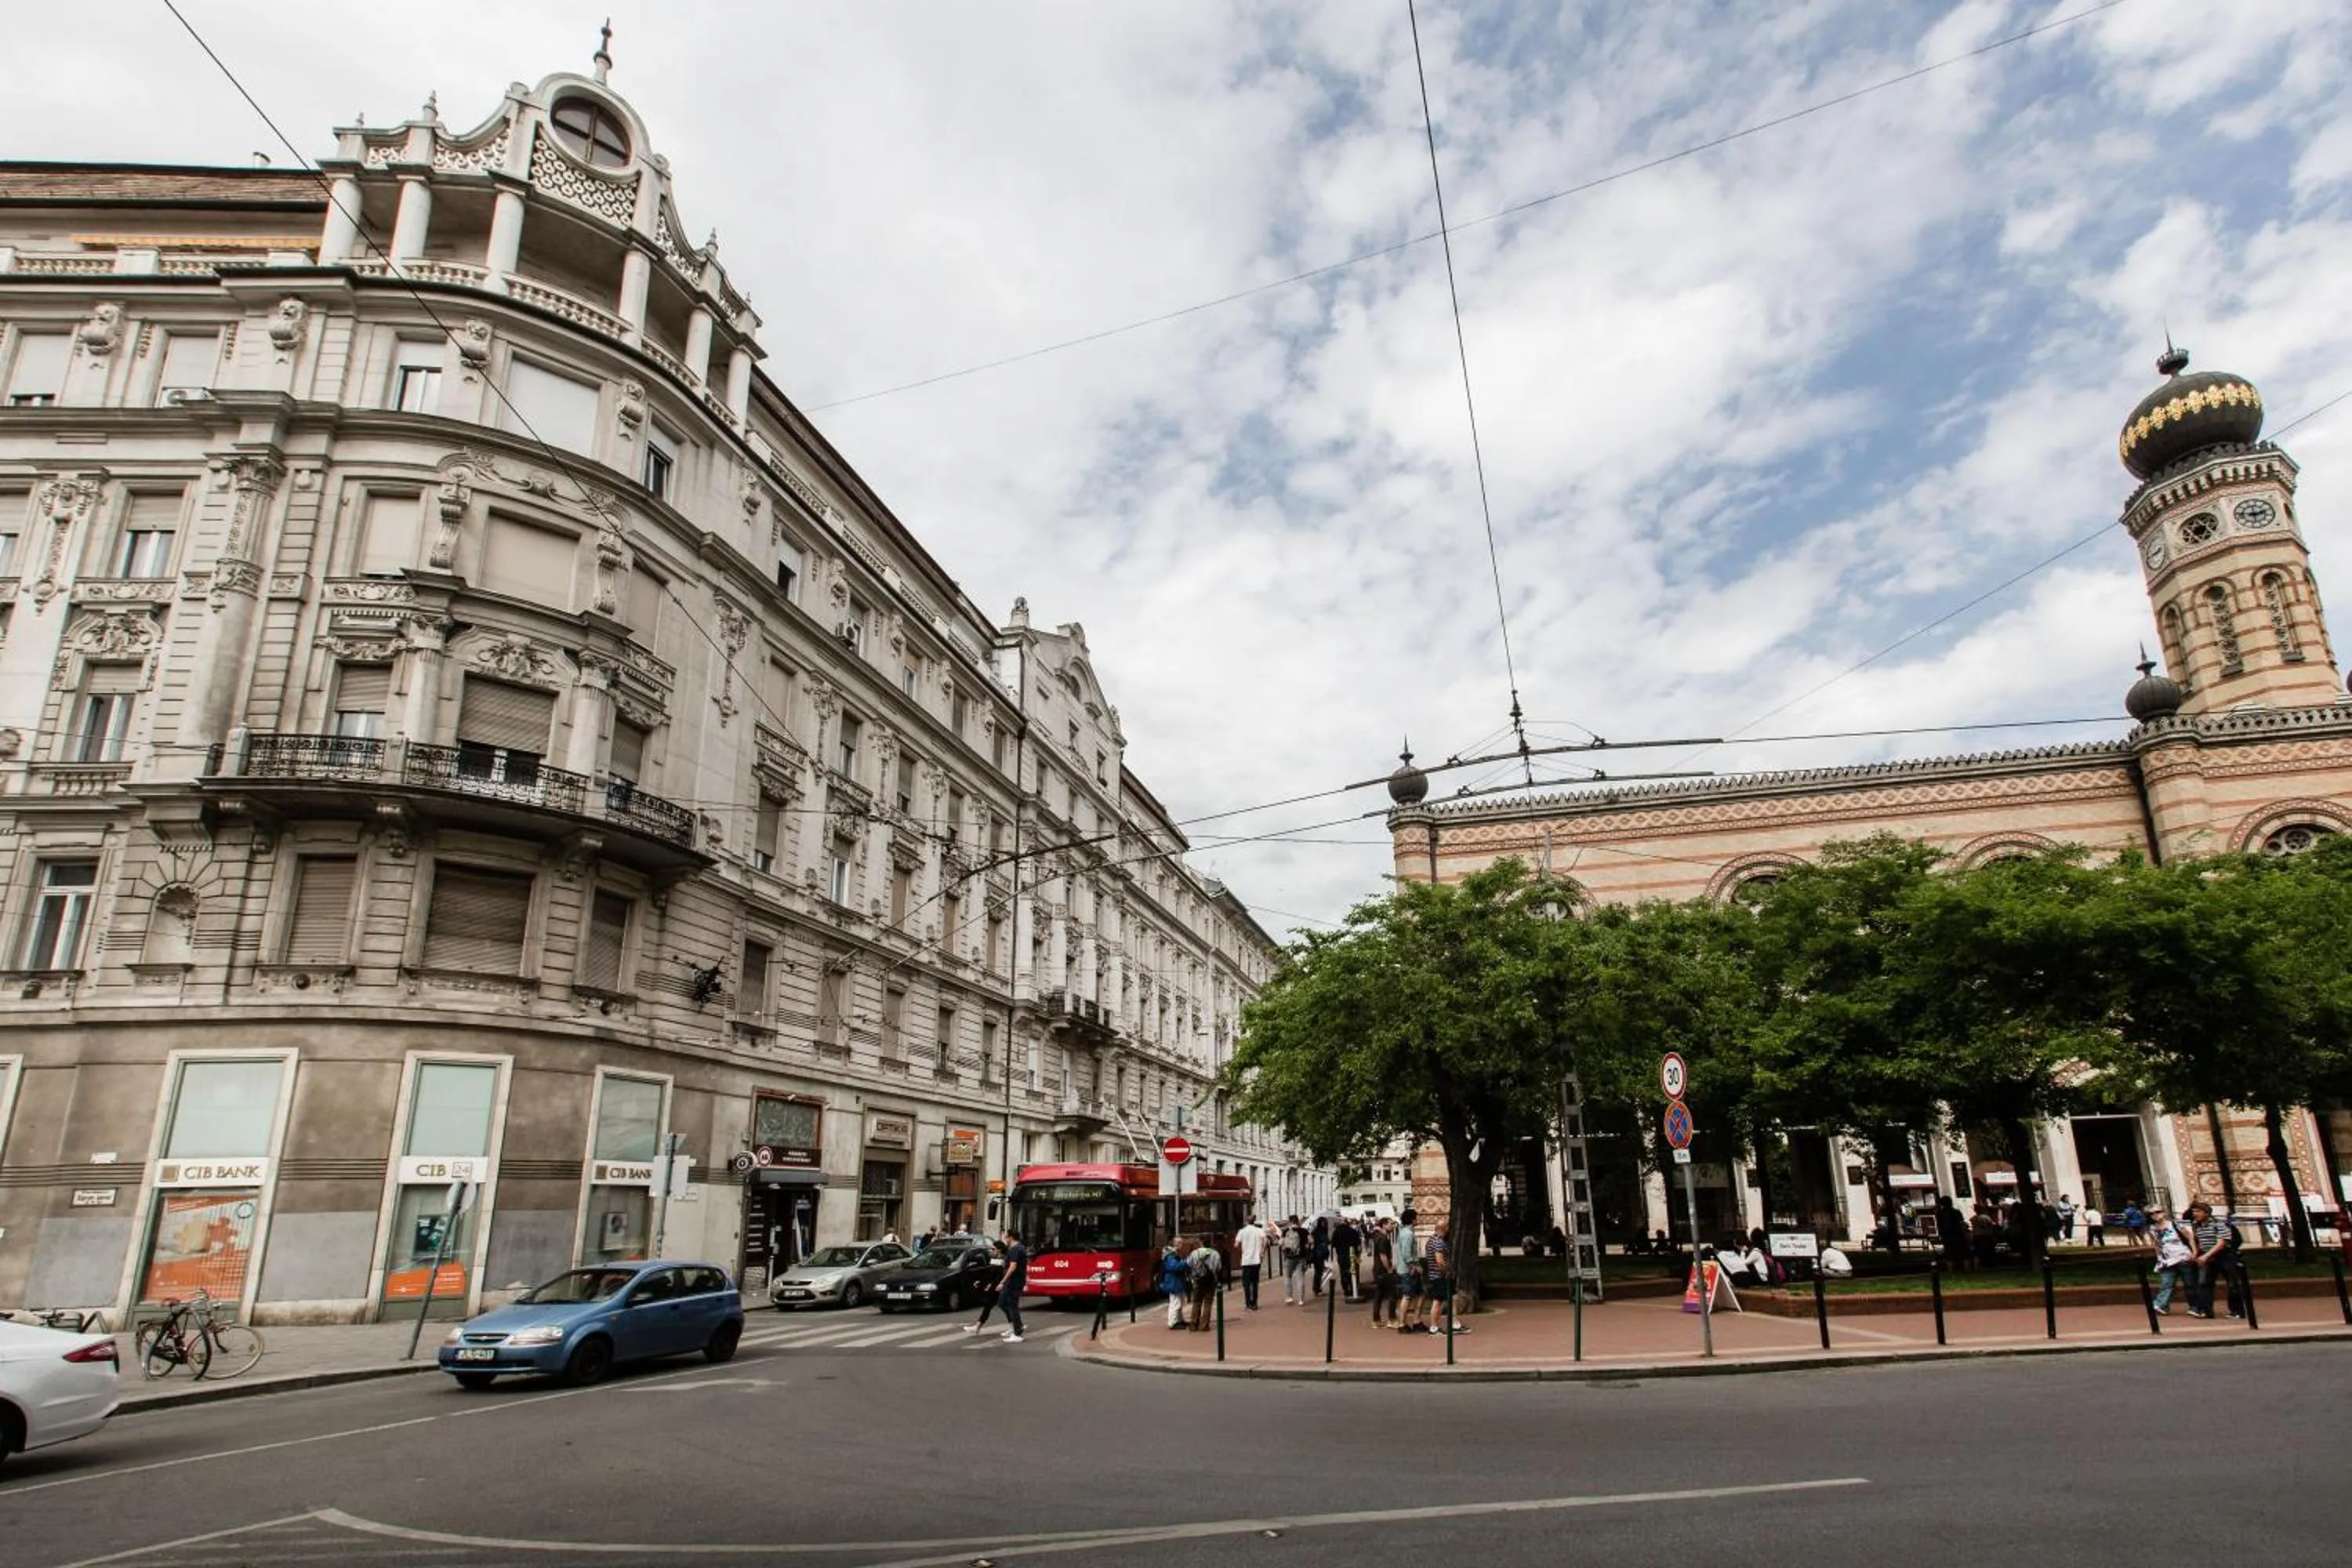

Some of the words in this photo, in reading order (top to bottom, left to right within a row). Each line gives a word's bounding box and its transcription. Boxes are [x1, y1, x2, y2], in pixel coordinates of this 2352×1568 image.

[1666, 1067, 1680, 1086] 30
[183, 1166, 212, 1179] CIB
[215, 1165, 260, 1178] BANK
[416, 1164, 446, 1177] CIB
[609, 1167, 626, 1178] CIB
